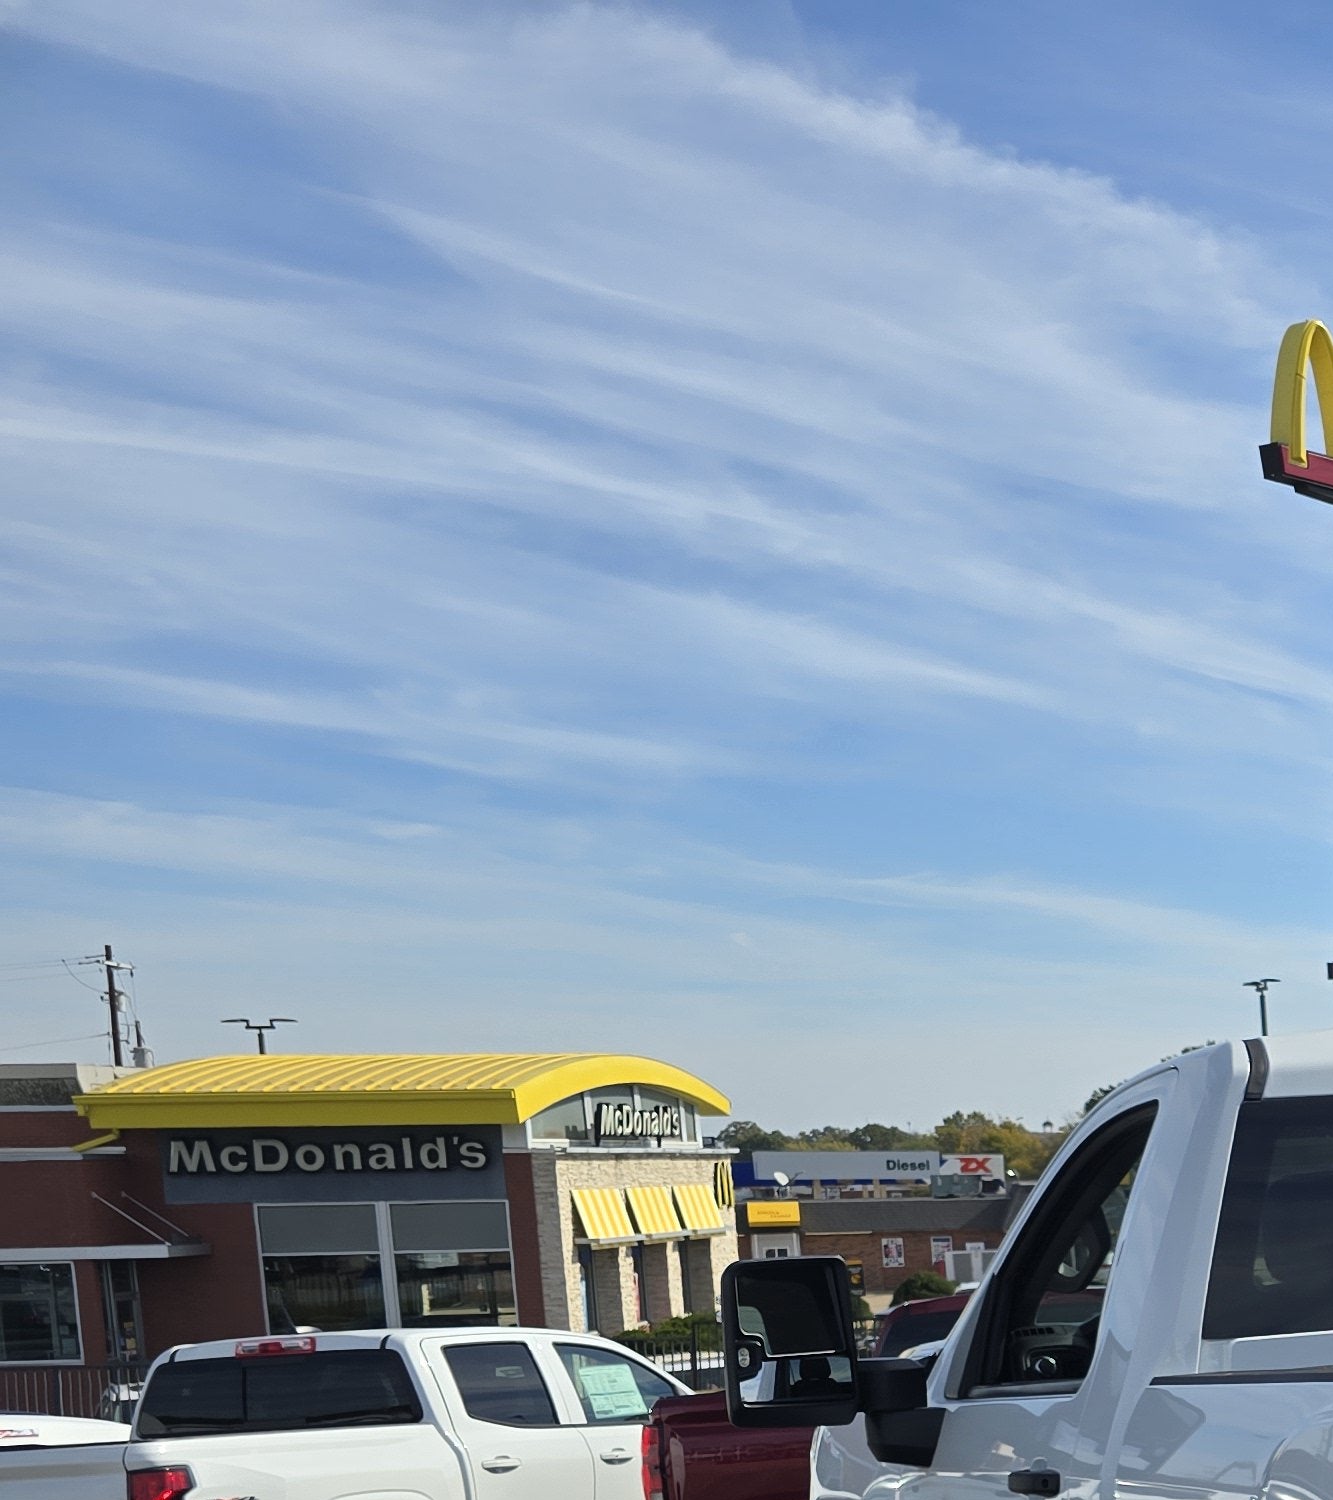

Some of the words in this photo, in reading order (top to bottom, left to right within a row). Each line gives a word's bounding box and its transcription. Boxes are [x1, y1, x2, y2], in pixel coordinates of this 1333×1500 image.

[600, 1103, 681, 1137] McDonald's
[169, 1136, 487, 1173] McDonald's
[886, 1160, 930, 1171] Diesel
